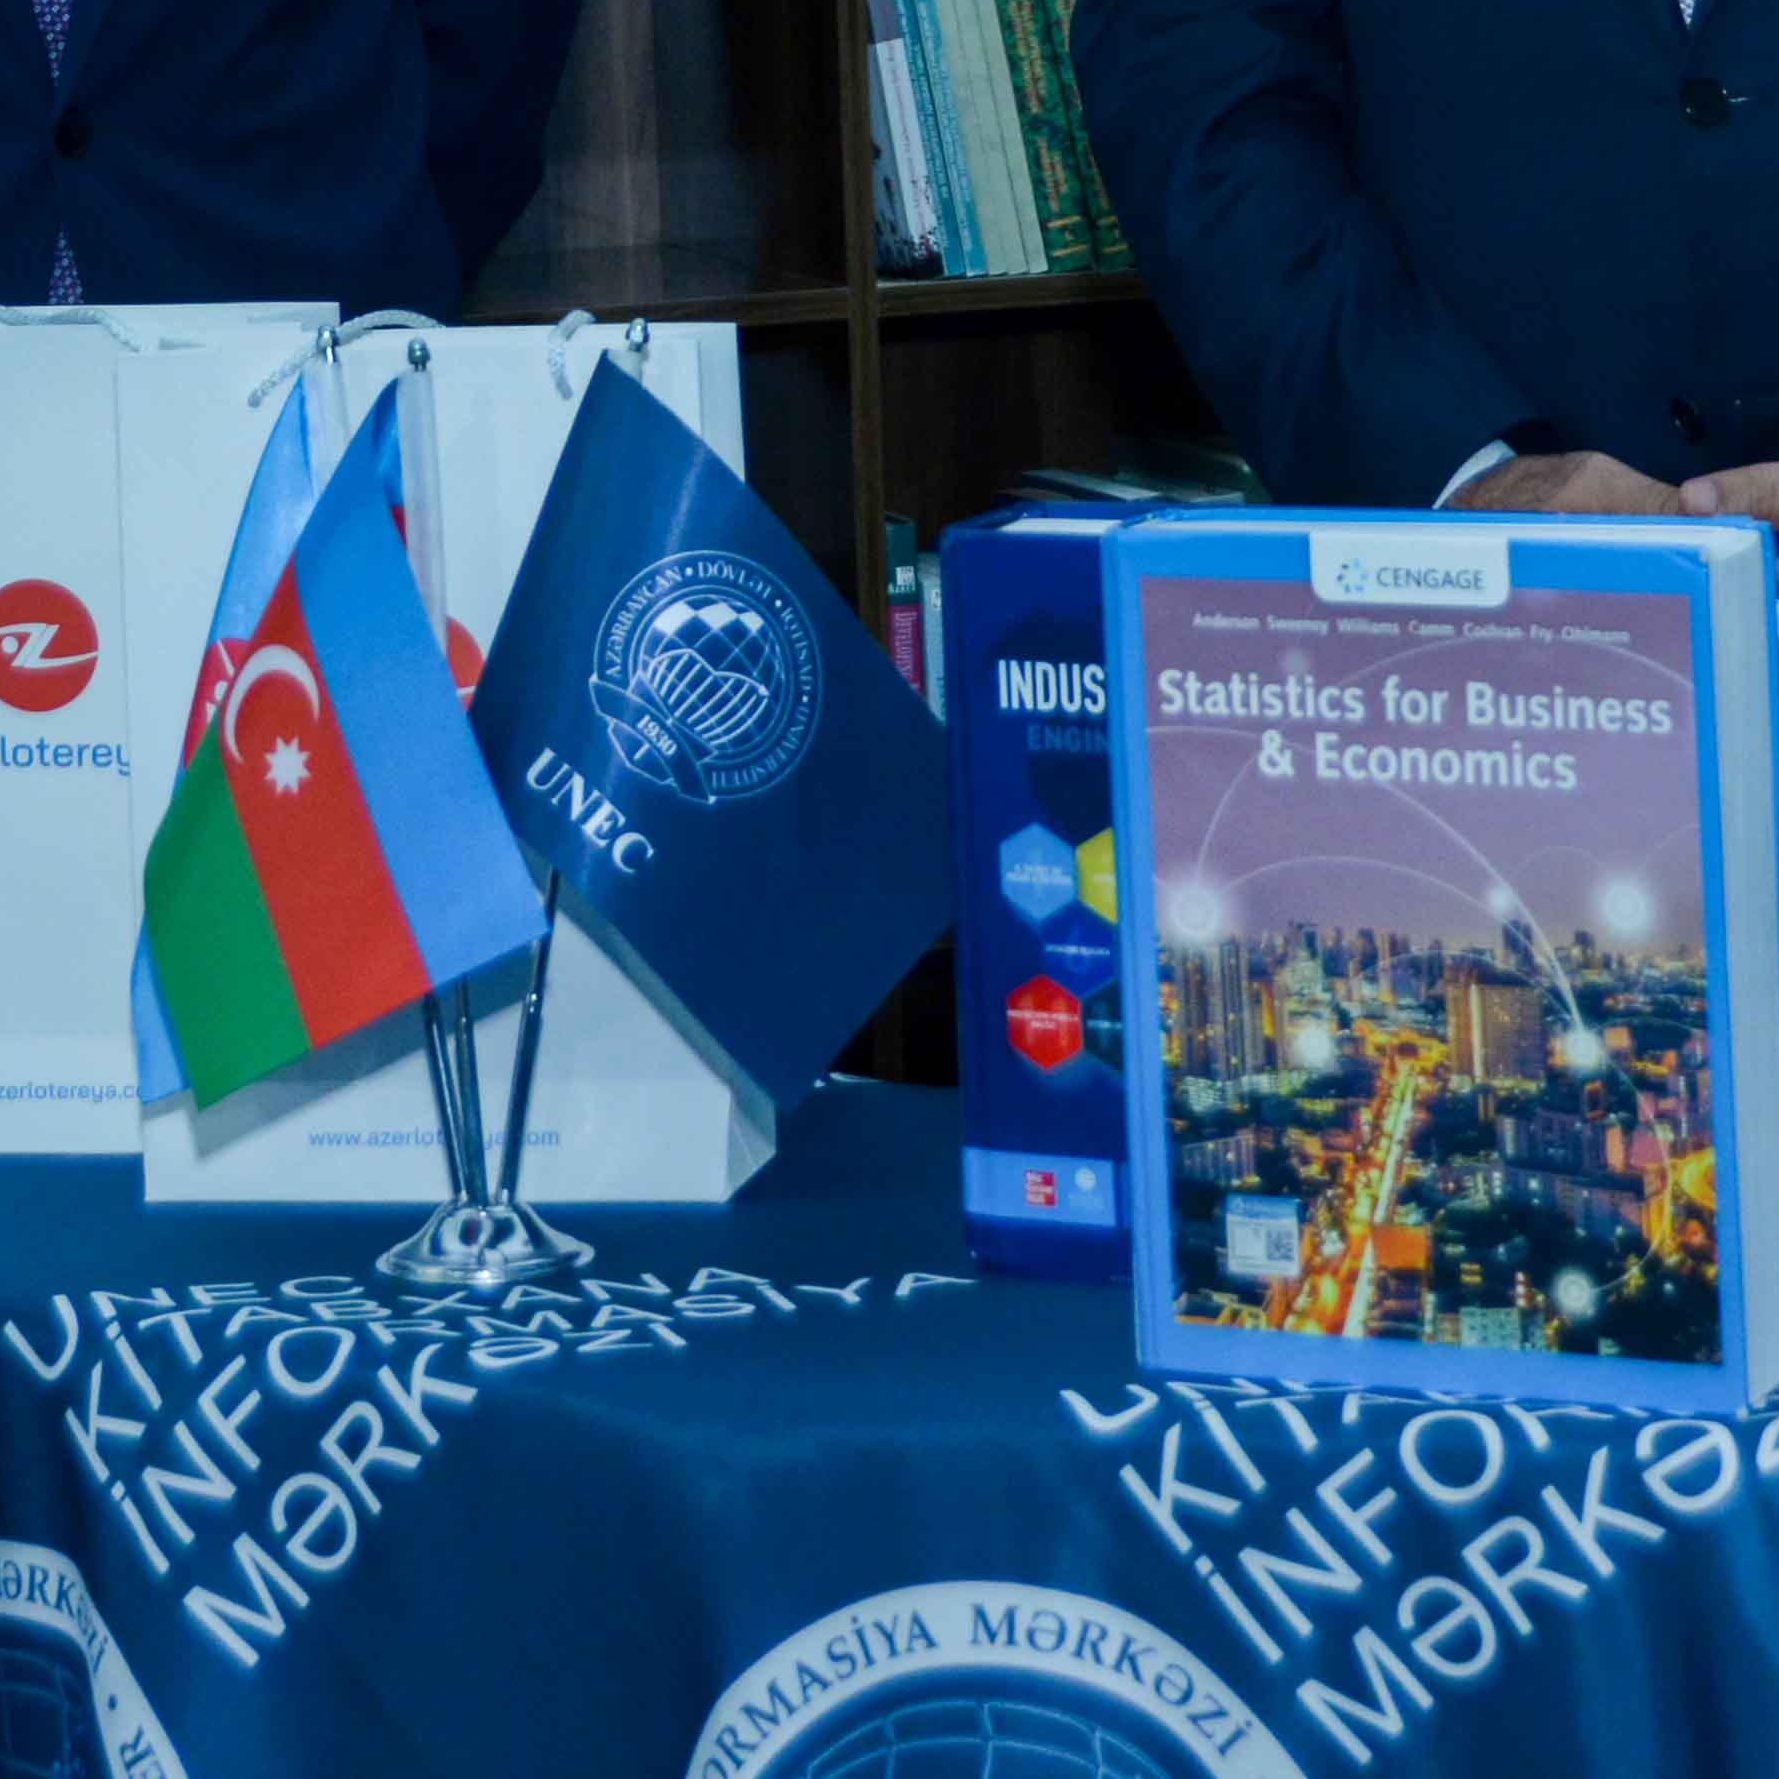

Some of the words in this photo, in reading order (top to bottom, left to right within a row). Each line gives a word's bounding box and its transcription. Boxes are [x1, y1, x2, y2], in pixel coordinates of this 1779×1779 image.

[1376, 566, 1486, 591] CENGAGE
[1336, 617, 1400, 636] Williams
[1530, 625, 1552, 643] Fry
[998, 658, 1107, 715] INDUS
[1157, 667, 1367, 724] Statistics
[1381, 674, 1450, 723] for
[1466, 680, 1674, 735] Business
[636, 714, 678, 756] 1930
[1026, 724, 1107, 754] ENGIN
[1257, 728, 1294, 778] &
[1315, 730, 1578, 789] Economics
[525, 746, 656, 876] UNEC
[3, 1275, 366, 1383] UNEC
[702, 1607, 940, 1779] ORMASİYA
[968, 1600, 1254, 1757] MƏRKƏZİ
